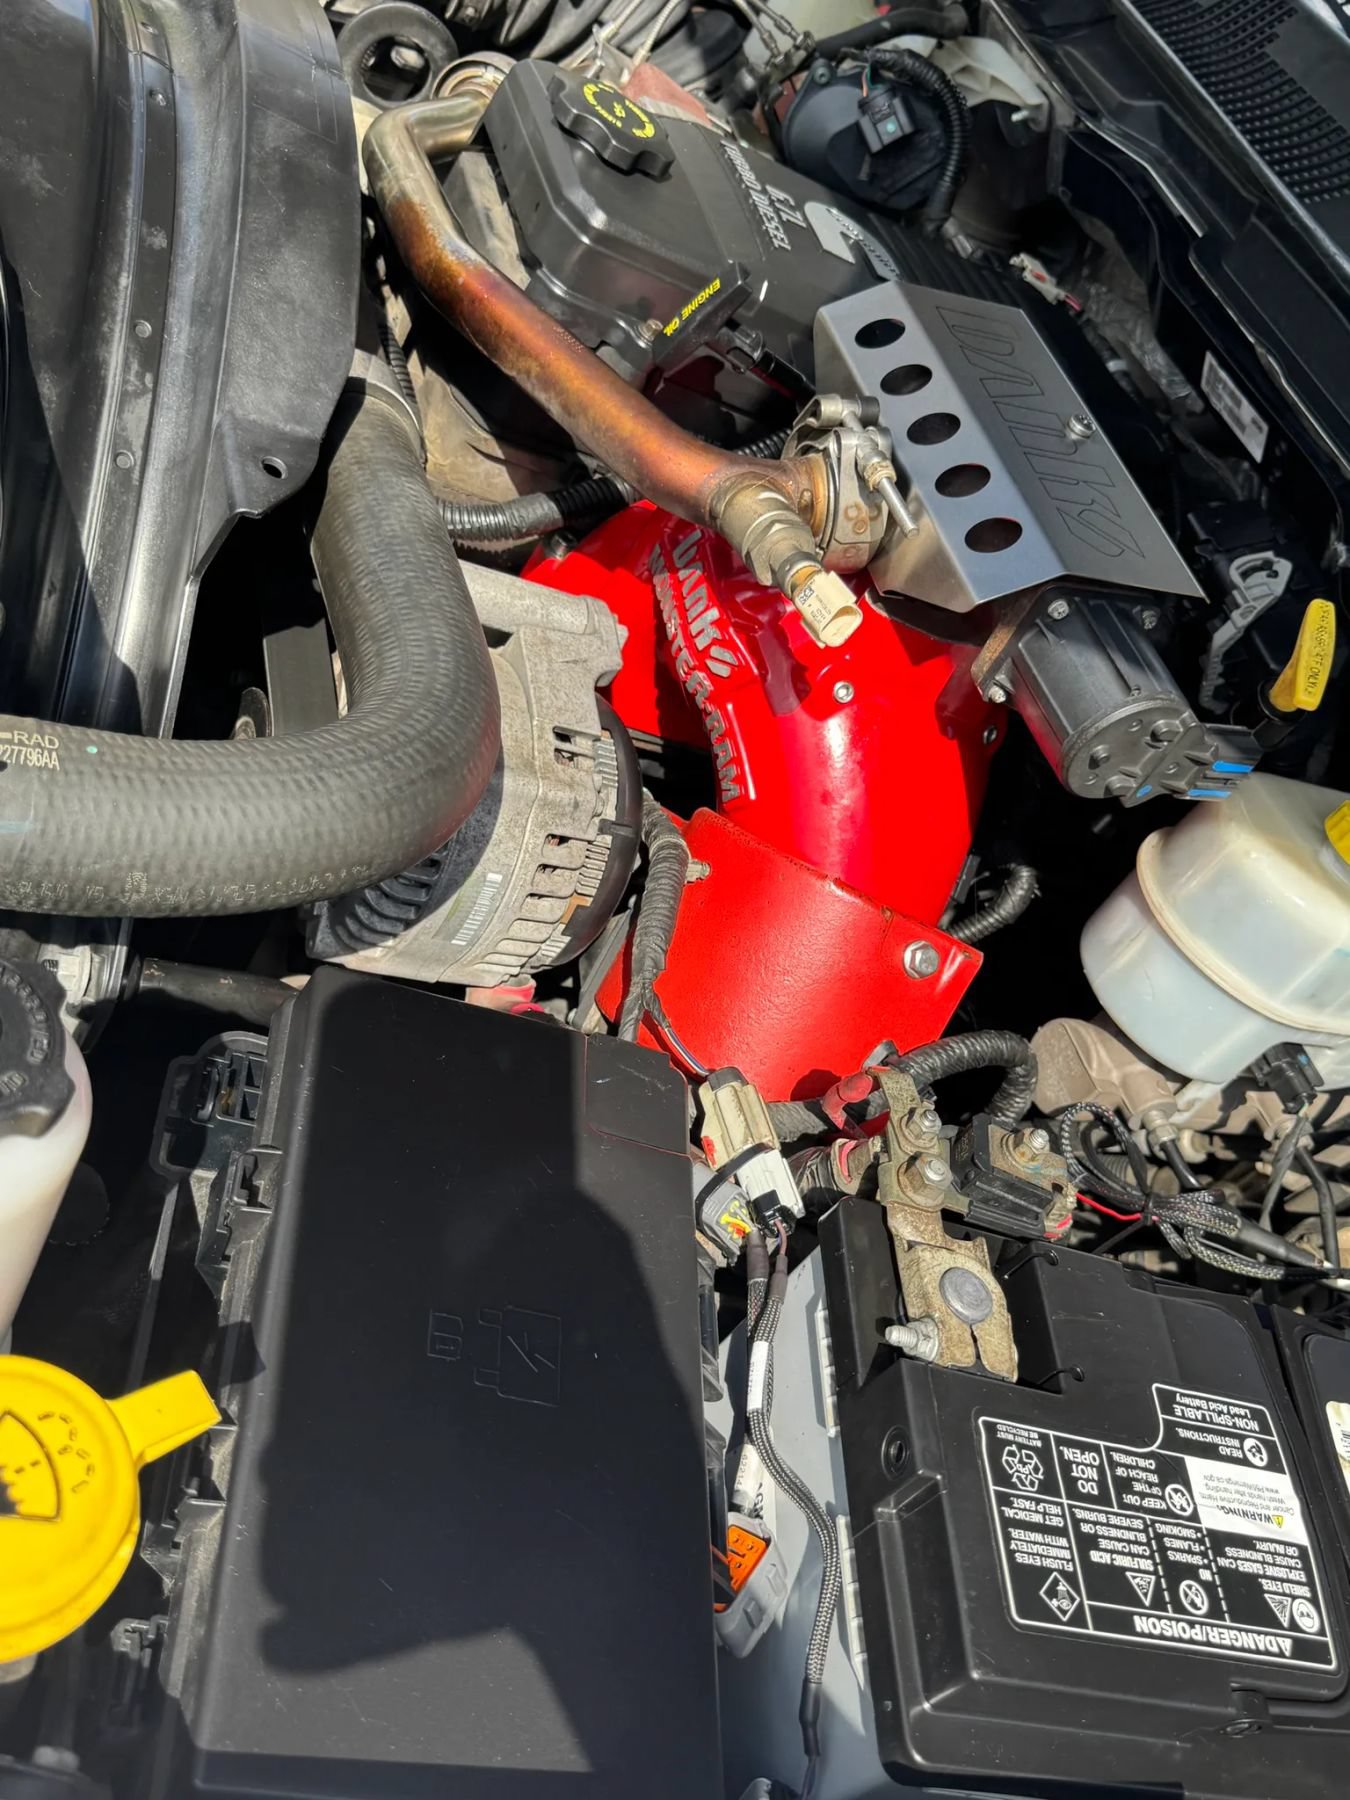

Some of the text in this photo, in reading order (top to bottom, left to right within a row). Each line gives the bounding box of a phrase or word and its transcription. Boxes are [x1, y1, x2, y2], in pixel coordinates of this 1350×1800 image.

[751, 190, 791, 251] DIESEL
[662, 277, 721, 337] ENGINE OIL
[1175, 1392, 1252, 1419] Lead Acid Battery
[1172, 1404, 1260, 1432] NON-SPILLABLE
[996, 1423, 1039, 1439] BE RECYCLED
[996, 1430, 1042, 1448] BATTERY MUST
[1175, 1427, 1241, 1448] INSTRUCTIONS.
[1059, 1446, 1100, 1466] OPEN.
[1110, 1451, 1156, 1470] CHILDREN.
[1218, 1446, 1244, 1459] READ
[1071, 1464, 1098, 1481] NOT
[1115, 1466, 1159, 1483] REACH OF
[1077, 1480, 1099, 1496] DO
[1131, 1481, 1163, 1497] OF THE
[1247, 1491, 1267, 1501] hands
[1009, 1496, 1062, 1516] HELP FAST.
[1122, 1493, 1168, 1510] KEEP OUT
[1259, 1503, 1272, 1512] and
[1272, 1506, 1295, 1516] Cancer
[1001, 1506, 1065, 1528] GET MEDICAL
[1072, 1507, 1144, 1530] SEVERE BURNS.
[1008, 1527, 1069, 1548] WITH WATER.
[1080, 1522, 1147, 1543] BLINDNESS OR
[1154, 1522, 1197, 1539] SMOKING
[1009, 1540, 1071, 1560] IMMEDIATELY
[1097, 1538, 1150, 1556] CAN CAUSE
[1163, 1537, 1200, 1552] FLAMES
[1252, 1540, 1299, 1556] OR INJURY.
[1014, 1552, 1074, 1572] FLUSH EYES
[1089, 1550, 1155, 1572] SULFURIC ACID
[1167, 1550, 1204, 1566] SPARKS
[1224, 1546, 1302, 1569] CAUSE BLINDNESS
[1198, 1568, 1213, 1581] NO
[1216, 1556, 1307, 1582] EXPLOSIVE GASES CAN
[1258, 1577, 1312, 1598] SHIELD EYES.
[1132, 1614, 1281, 1654] DANGER/POISON
